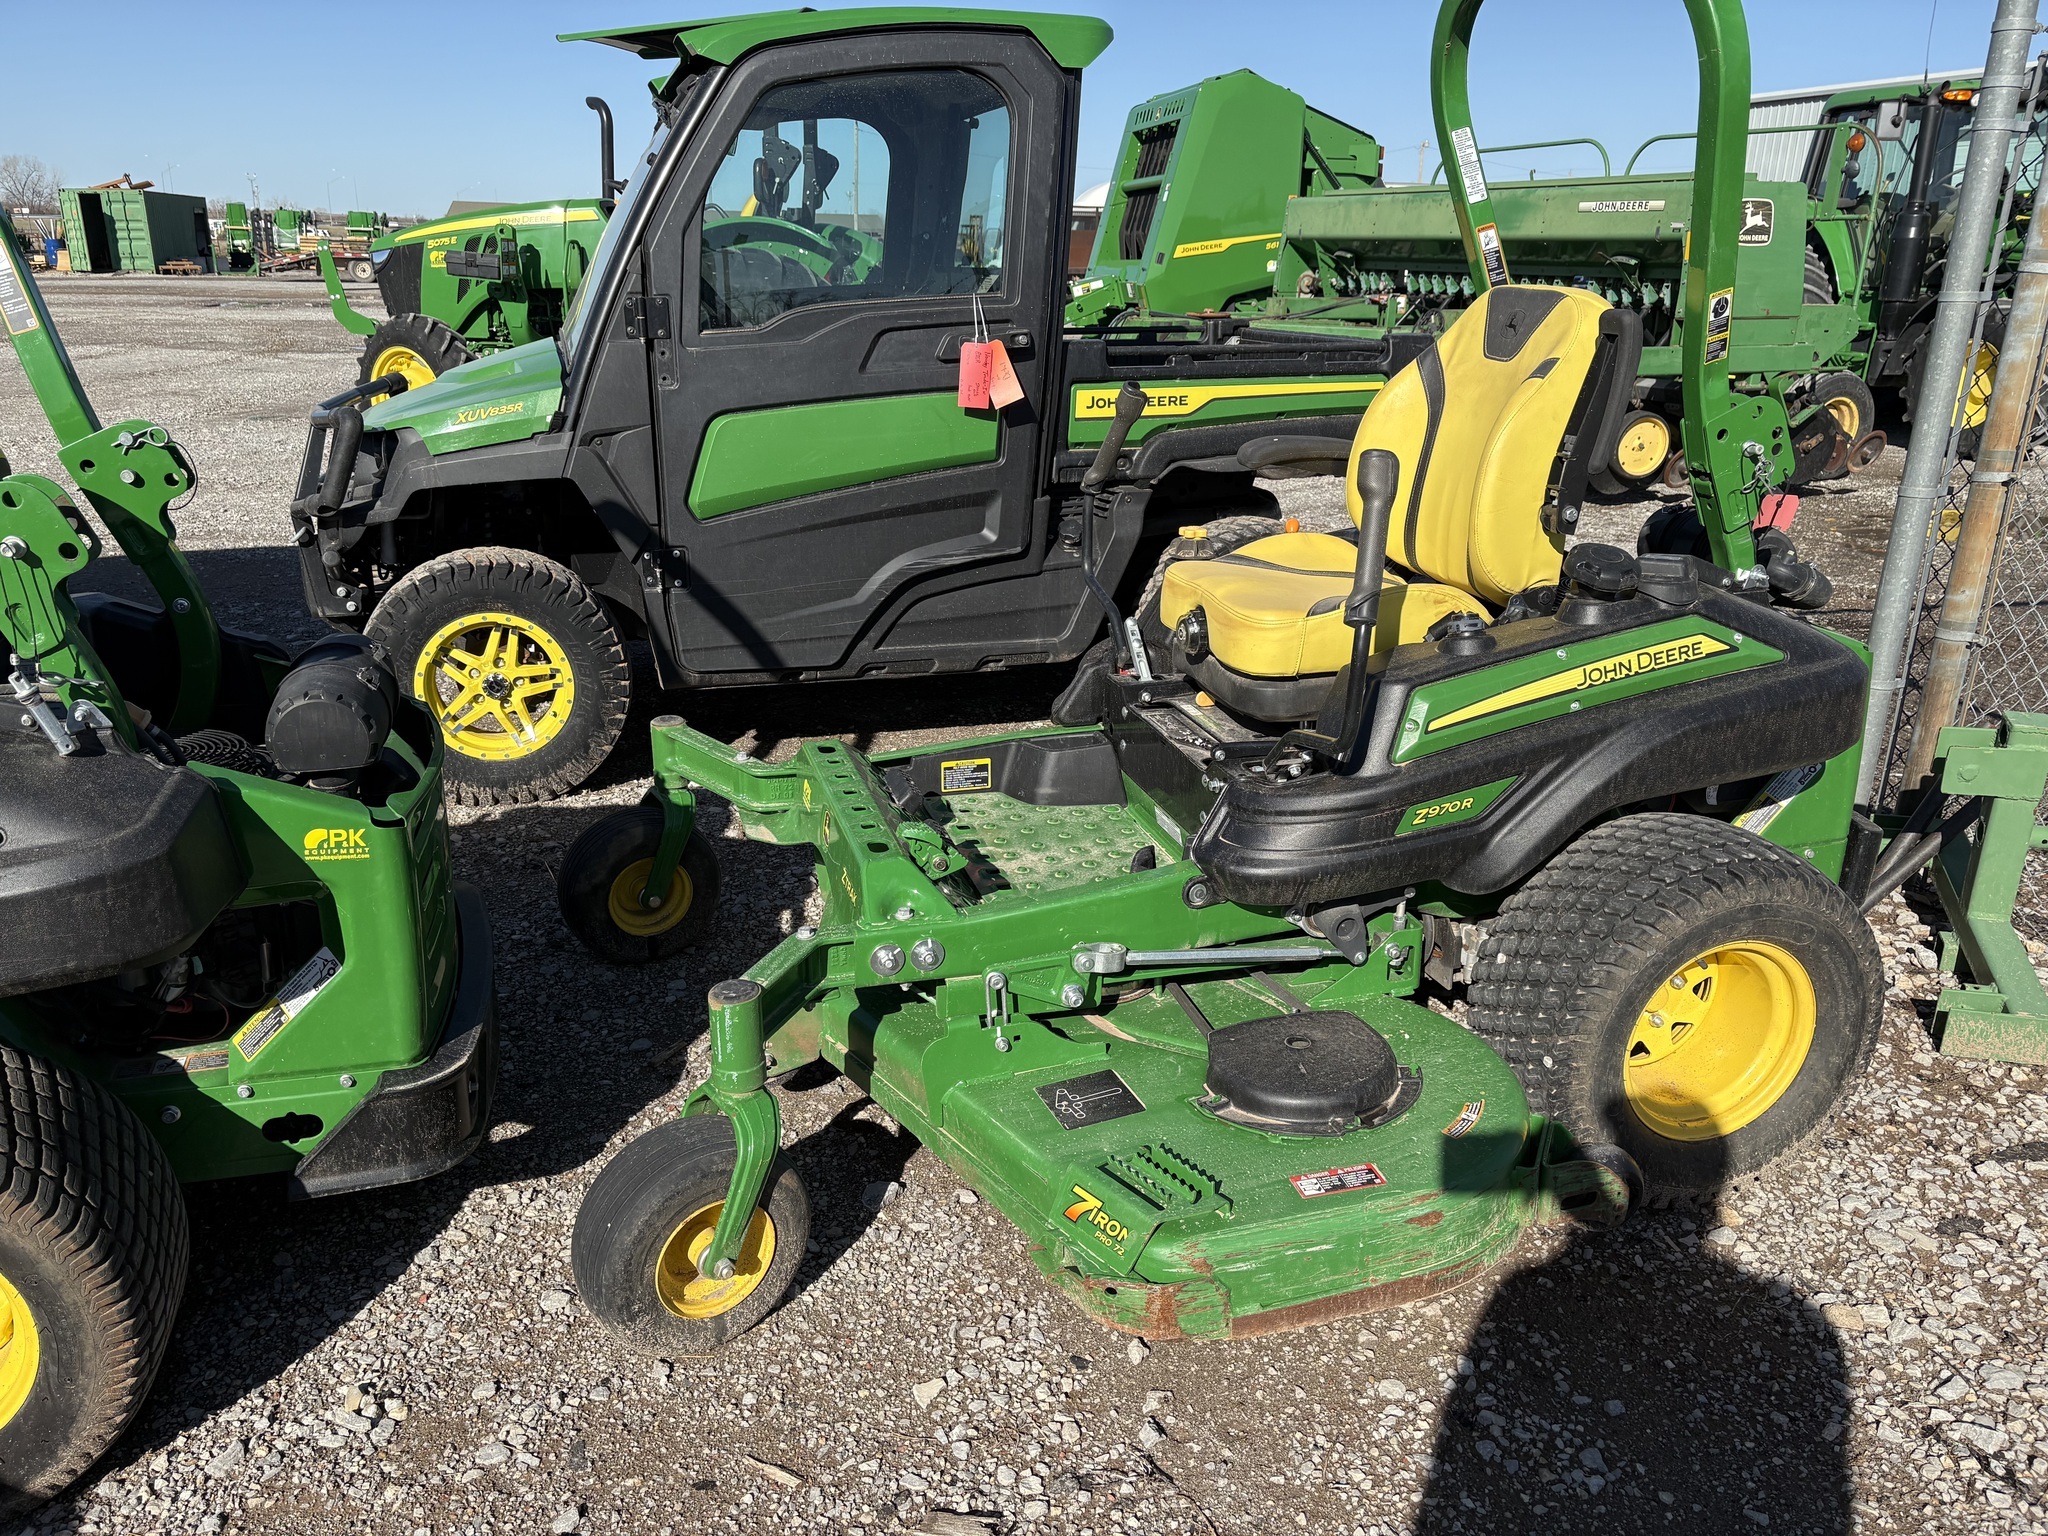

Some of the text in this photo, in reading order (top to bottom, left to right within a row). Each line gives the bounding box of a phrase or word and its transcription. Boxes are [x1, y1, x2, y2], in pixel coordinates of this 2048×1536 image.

[1593, 201, 1649, 211] JOHN DEERE
[499, 215, 552, 225] JOHN DEERE
[1181, 243, 1223, 254] JOHN DEERE
[1086, 395, 1189, 409] JOH EERE
[453, 402, 524, 425] XUV835R
[1576, 641, 1703, 688] JOHN DEERE
[1411, 797, 1474, 825] Z970R
[329, 828, 367, 848] P&K
[304, 847, 370, 856] EQUIPMENT
[304, 853, 370, 861] www.pkequipment.com
[1094, 1230, 1125, 1256] PRO 72
